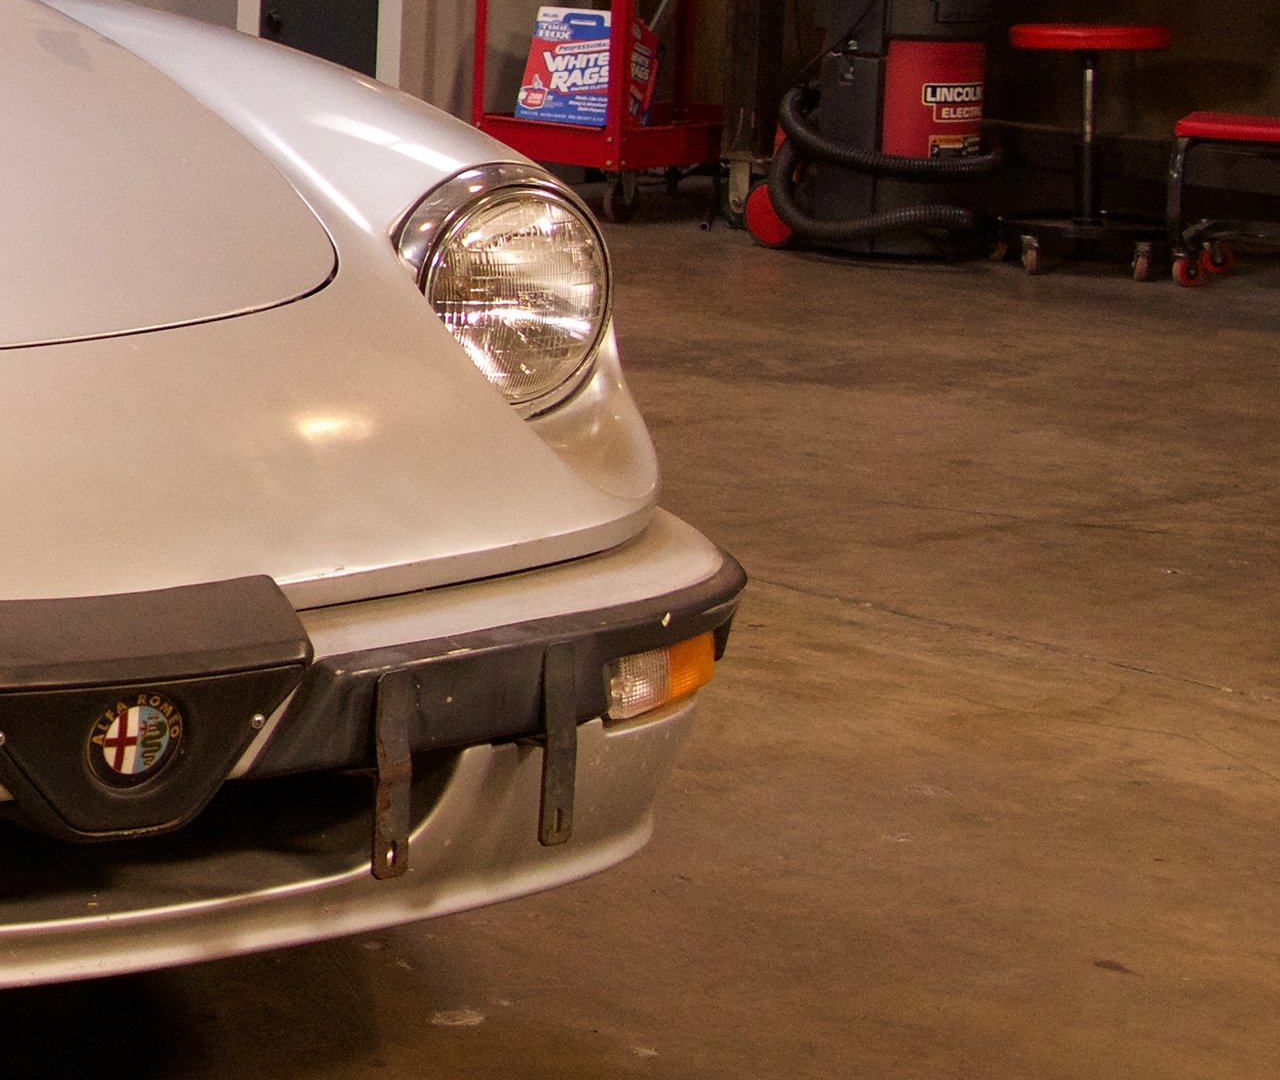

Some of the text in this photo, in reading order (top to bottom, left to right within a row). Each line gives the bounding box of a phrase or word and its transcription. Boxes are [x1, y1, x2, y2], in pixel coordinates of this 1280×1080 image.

[543, 51, 610, 73] WHITE
[550, 67, 609, 92] RAGS
[92, 694, 181, 746] ALFA ROMEO
